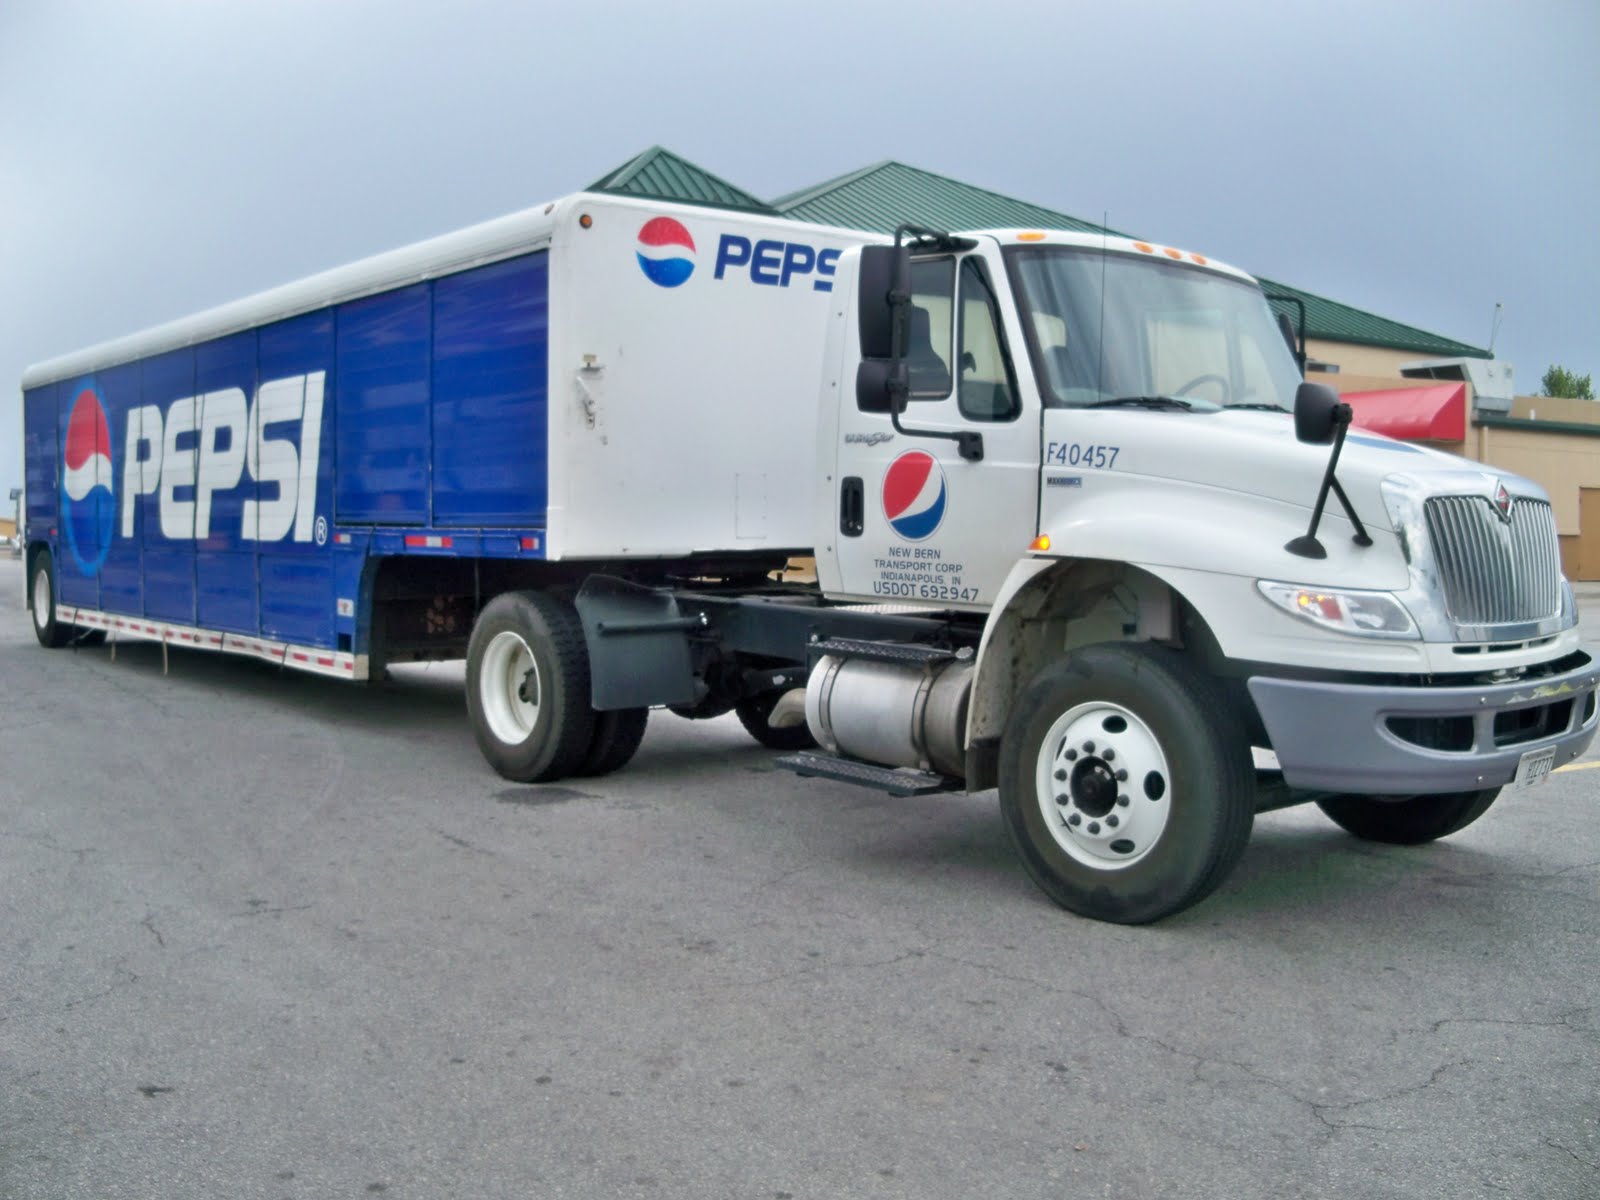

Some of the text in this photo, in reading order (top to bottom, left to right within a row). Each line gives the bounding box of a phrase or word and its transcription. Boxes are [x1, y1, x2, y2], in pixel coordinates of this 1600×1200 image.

[121, 370, 326, 542] PEPSI
[1047, 442, 1119, 469] F40457
[888, 547, 941, 559] NEW BERN
[874, 559, 962, 573] TRANSPORT CORP
[951, 575, 961, 585] IN
[873, 581, 979, 601] USDOT 692947
